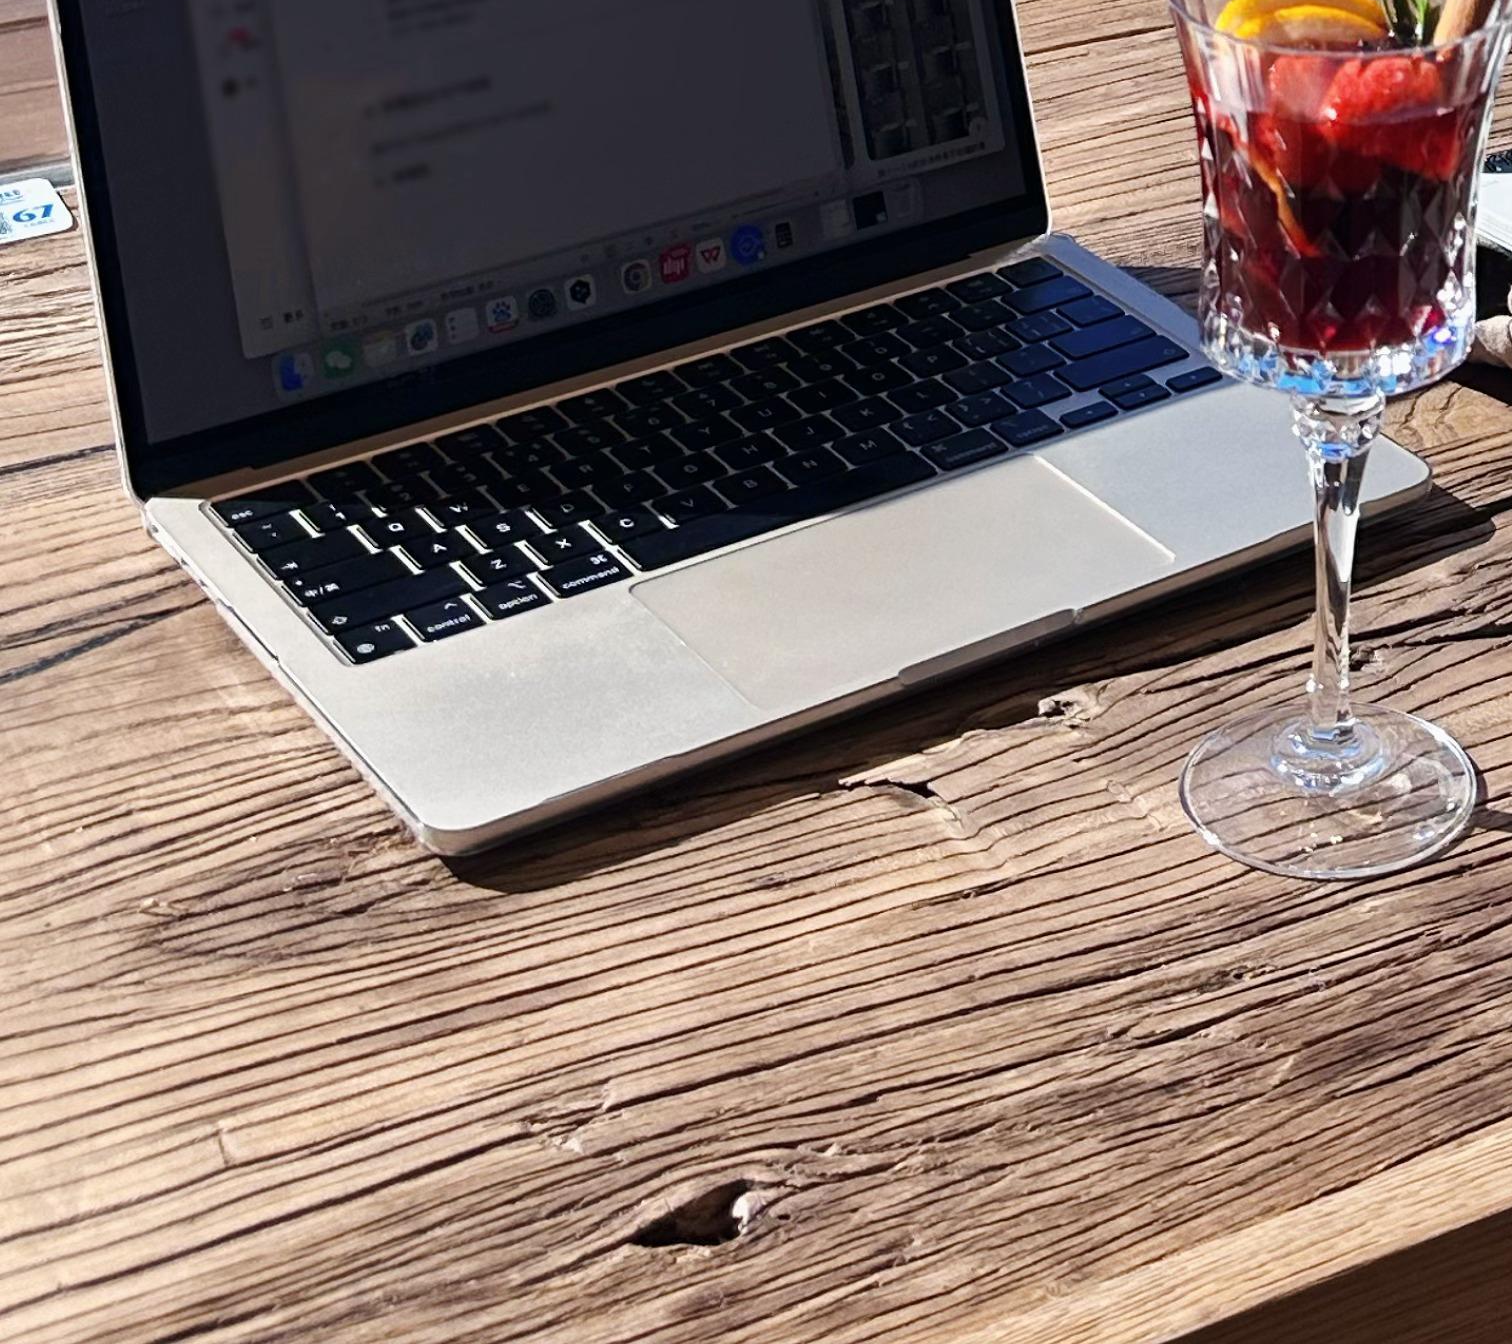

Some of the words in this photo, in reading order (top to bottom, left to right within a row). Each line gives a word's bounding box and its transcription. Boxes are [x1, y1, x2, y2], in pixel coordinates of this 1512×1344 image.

[562, 565, 621, 590] command
[498, 593, 539, 611] option
[427, 613, 472, 634] control
